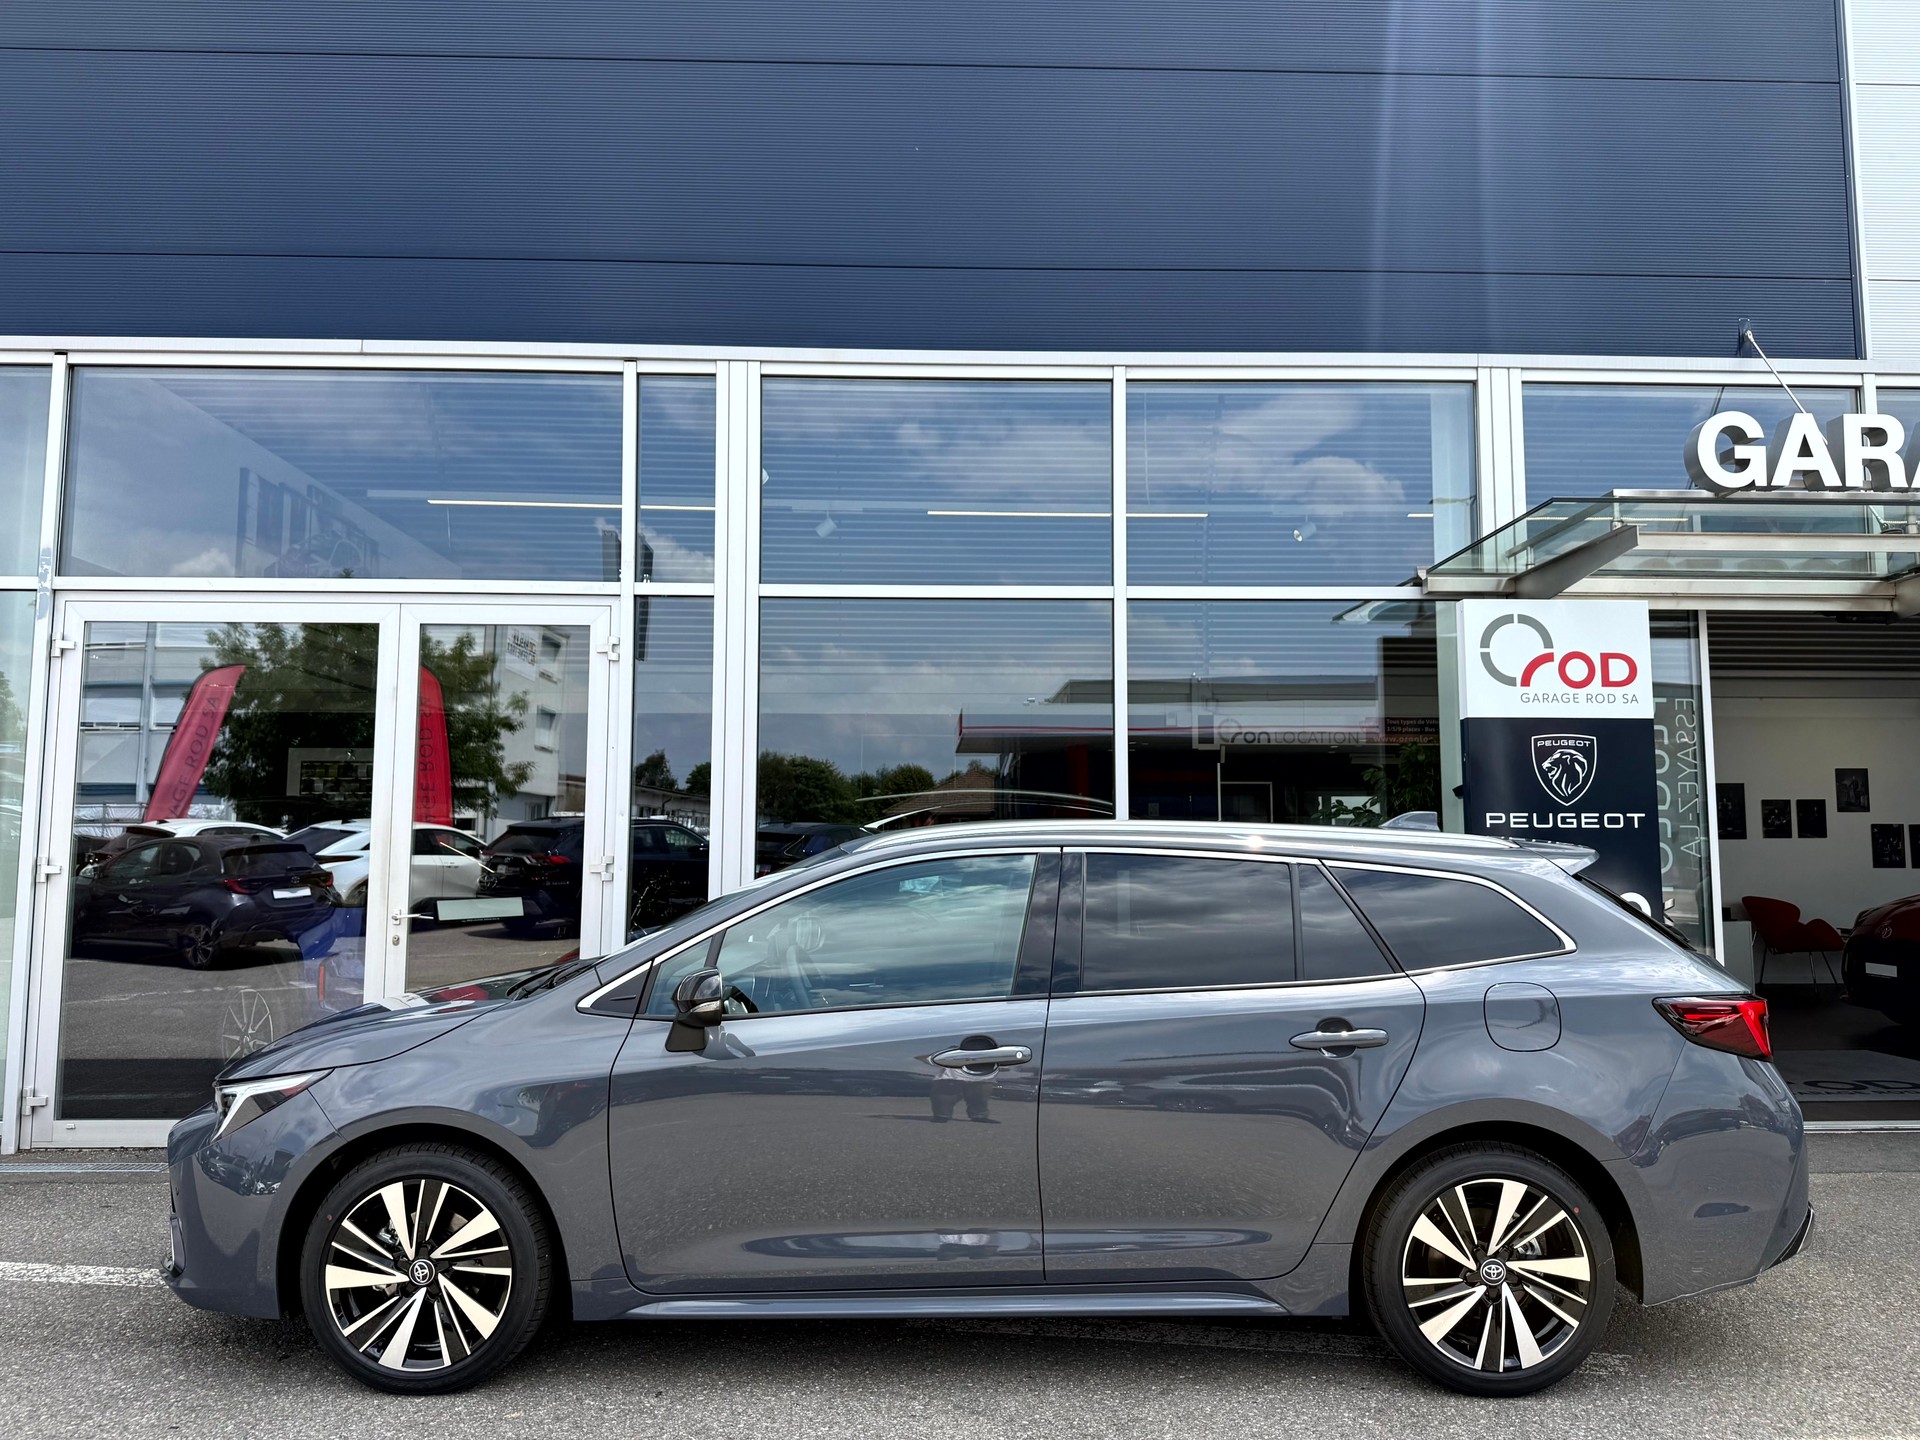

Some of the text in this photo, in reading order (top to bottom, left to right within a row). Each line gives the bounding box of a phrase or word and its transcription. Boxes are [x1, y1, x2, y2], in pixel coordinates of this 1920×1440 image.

[1697, 410, 1920, 489] GAR
[1520, 692, 1639, 705] GARAGE ROD SA
[185, 726, 209, 769] ROD
[205, 696, 220, 720] SA
[1275, 731, 1359, 744] LOCATION
[1537, 739, 1592, 748] PEUGEOT
[1486, 812, 1646, 829] PEUGEOT
